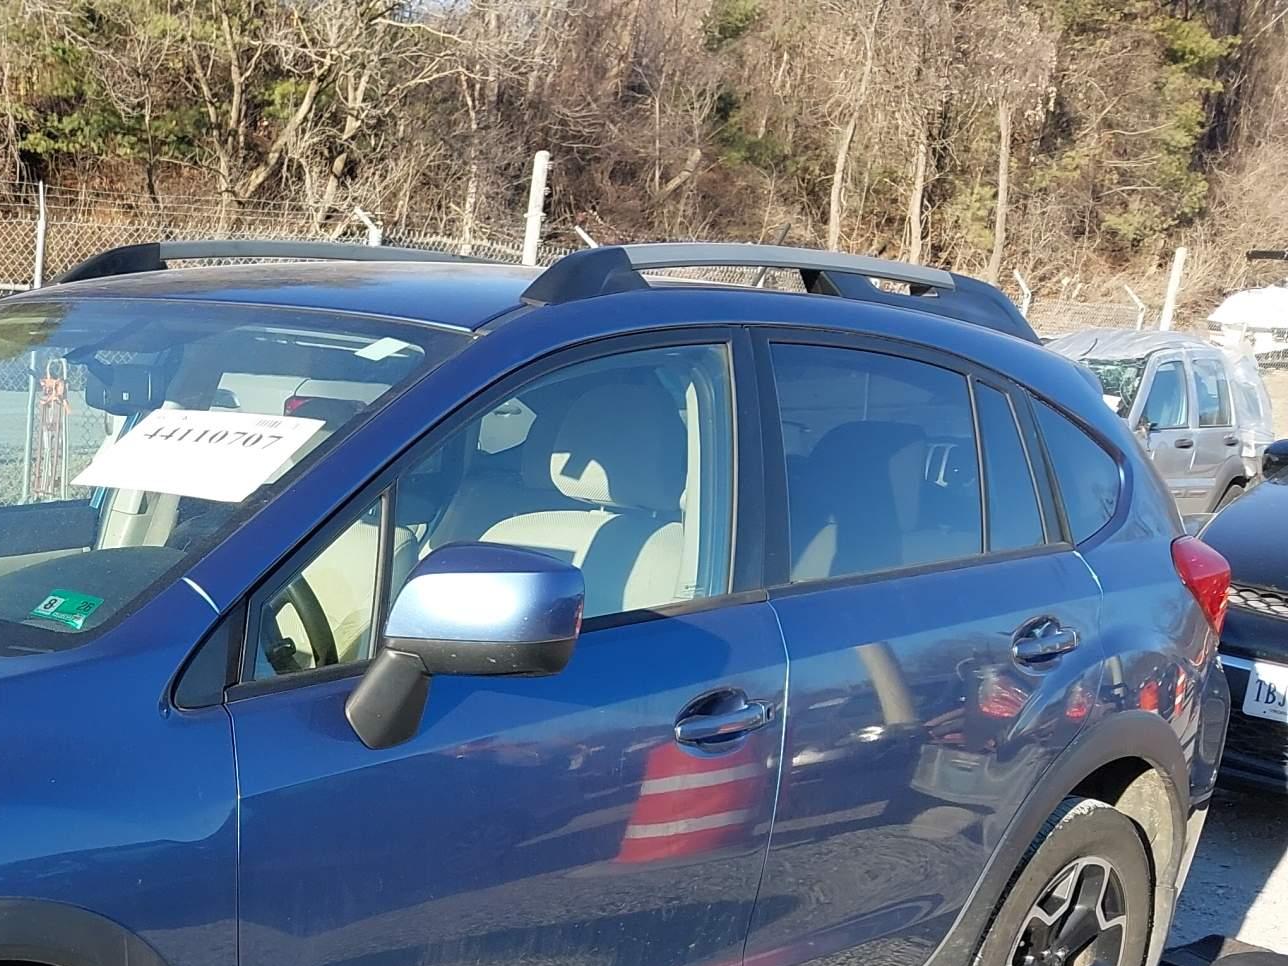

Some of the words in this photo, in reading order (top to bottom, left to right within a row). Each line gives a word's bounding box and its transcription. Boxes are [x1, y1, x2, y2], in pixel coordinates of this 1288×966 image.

[143, 426, 284, 450] 44110707
[43, 598, 58, 610] 8
[76, 601, 96, 613] 26
